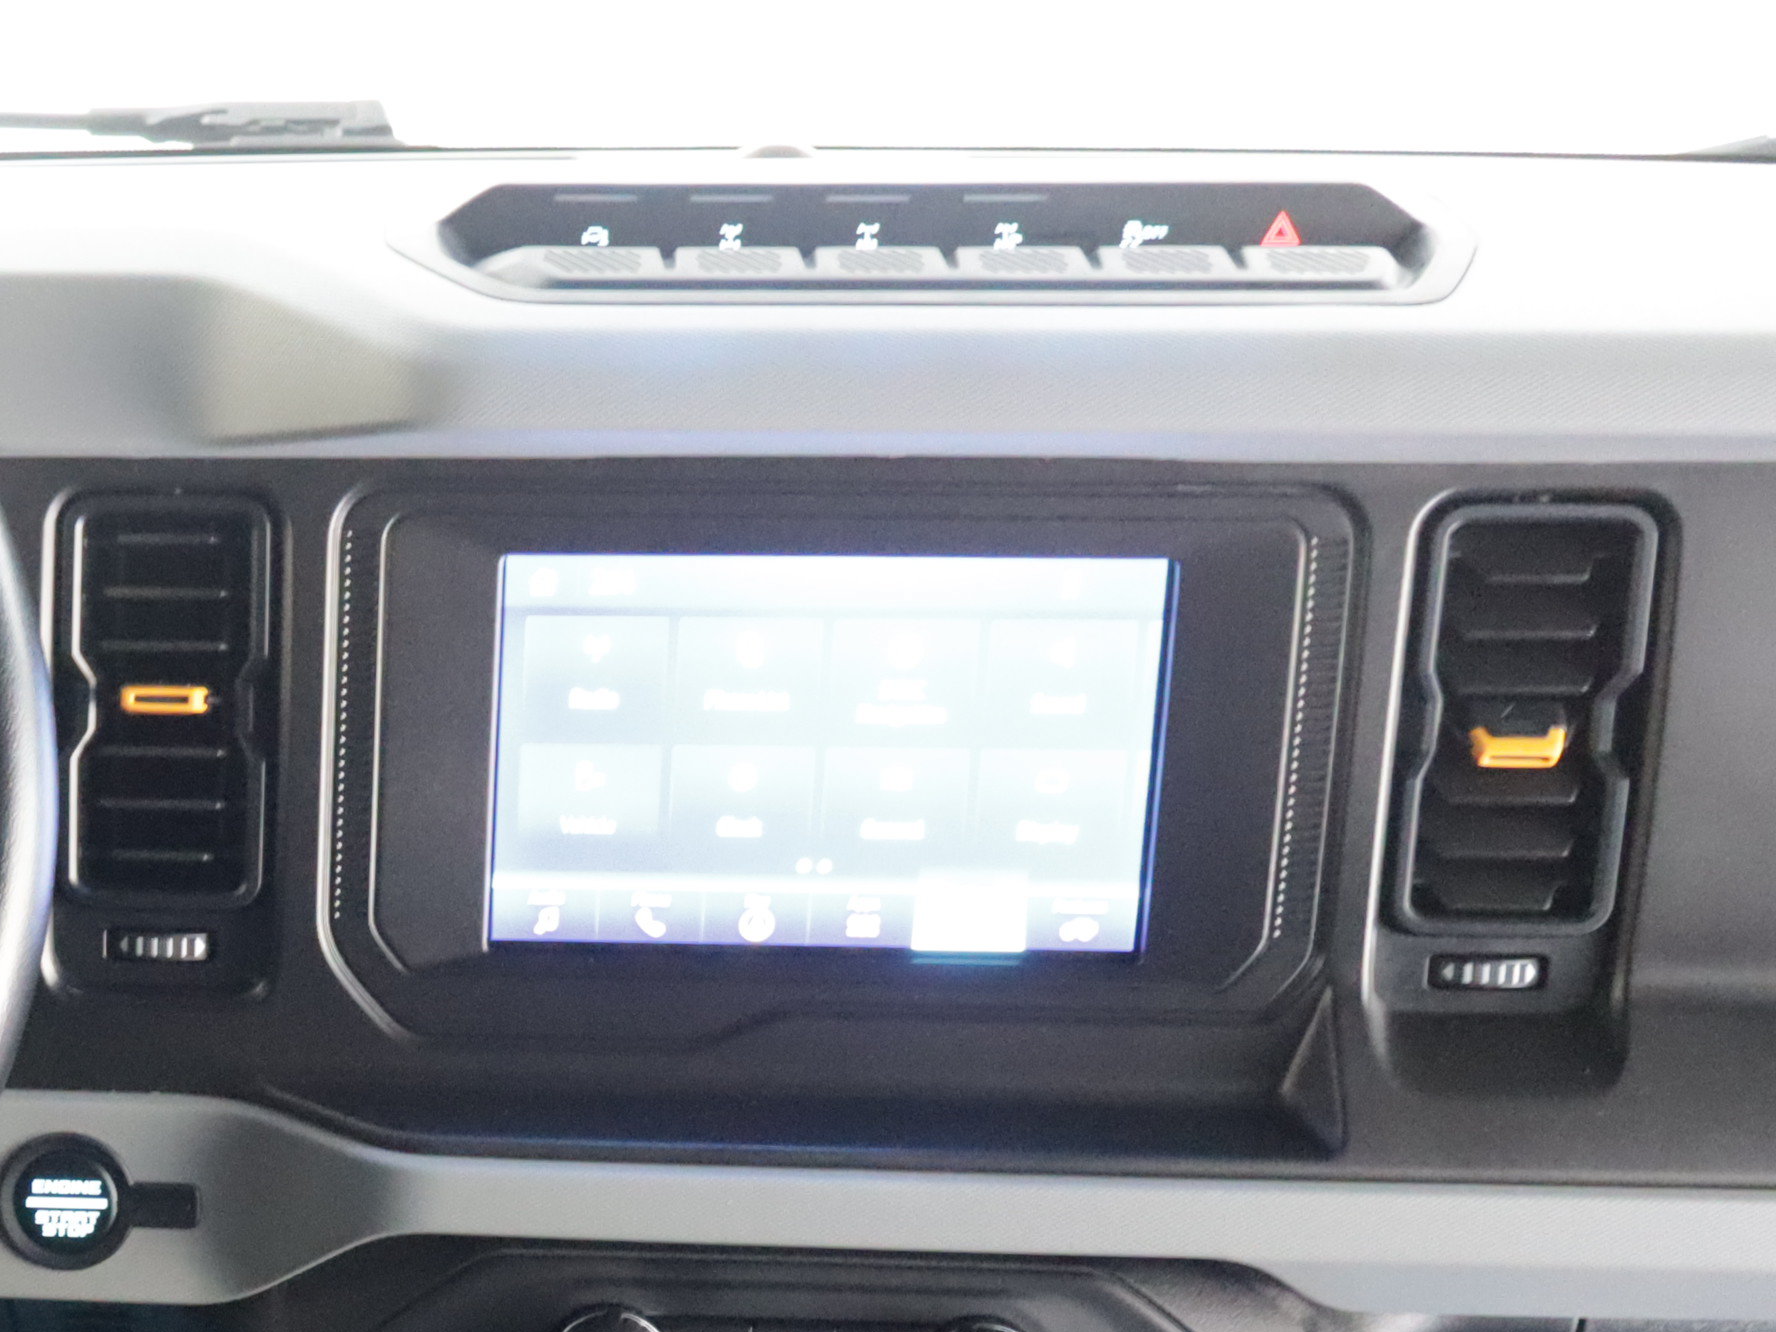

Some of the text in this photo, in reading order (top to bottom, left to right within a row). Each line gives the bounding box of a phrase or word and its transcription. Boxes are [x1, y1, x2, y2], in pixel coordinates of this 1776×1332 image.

[31, 1178, 102, 1196] ENGINE
[34, 1210, 100, 1225] START
[42, 1223, 95, 1238] STOP
